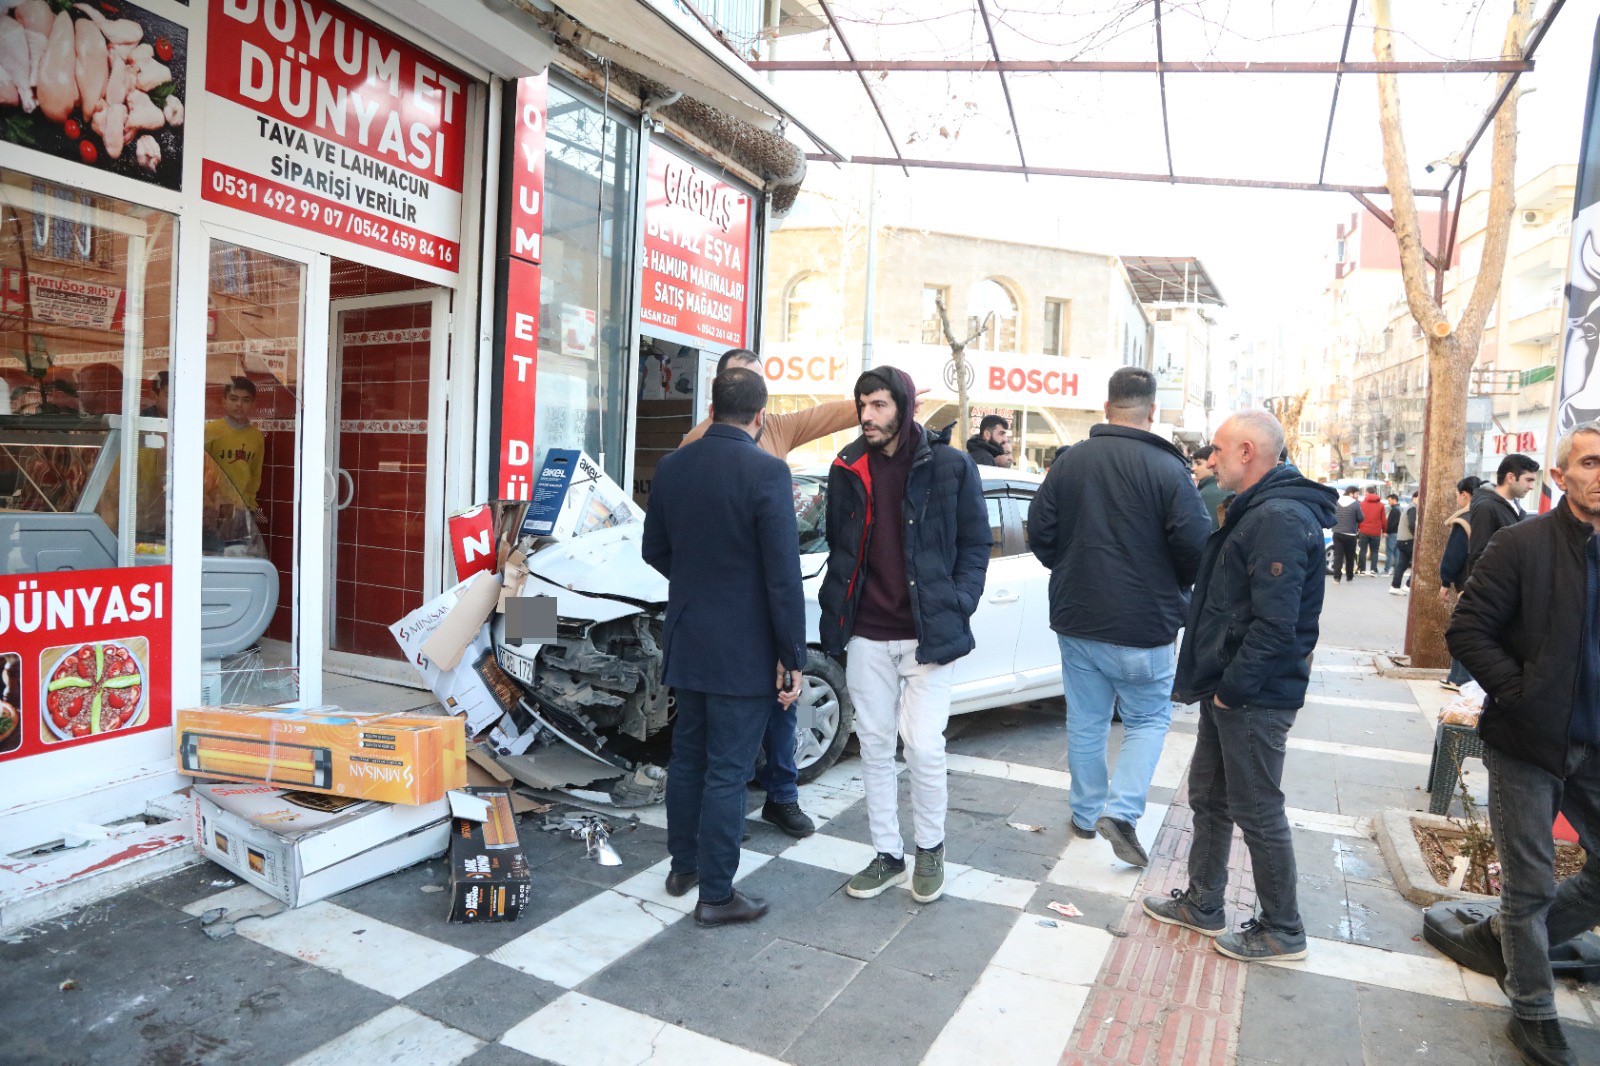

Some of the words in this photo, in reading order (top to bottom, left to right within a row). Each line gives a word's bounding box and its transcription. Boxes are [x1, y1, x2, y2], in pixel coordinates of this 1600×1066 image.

[239, 39, 444, 177] DÜNYASI
[413, 62, 461, 124] ET
[256, 115, 308, 154] TAVA
[312, 138, 336, 164] VE
[340, 149, 429, 200] LAHMACUN
[212, 171, 257, 202] 0531
[263, 188, 295, 214] 492
[300, 200, 320, 221] 99
[324, 207, 343, 229] 07
[391, 228, 416, 251] 659
[419, 239, 435, 258] 84
[438, 245, 452, 262] 16
[270, 154, 351, 200] SİPARİŞİ
[355, 185, 417, 224] VERİLİR
[664, 164, 731, 233] ÇAĞDAŞ
[650, 249, 689, 282] HAMUR
[690, 264, 745, 302] MAKİNALARI
[704, 232, 742, 272] EŞYA
[654, 281, 685, 311] SATIŞ
[686, 291, 732, 324] MAĞAZASI
[662, 314, 677, 327] ZATİ
[513, 312, 534, 382] ET
[764, 356, 848, 381] OSCH
[988, 366, 1078, 397] BOSCH
[462, 529, 491, 564] N
